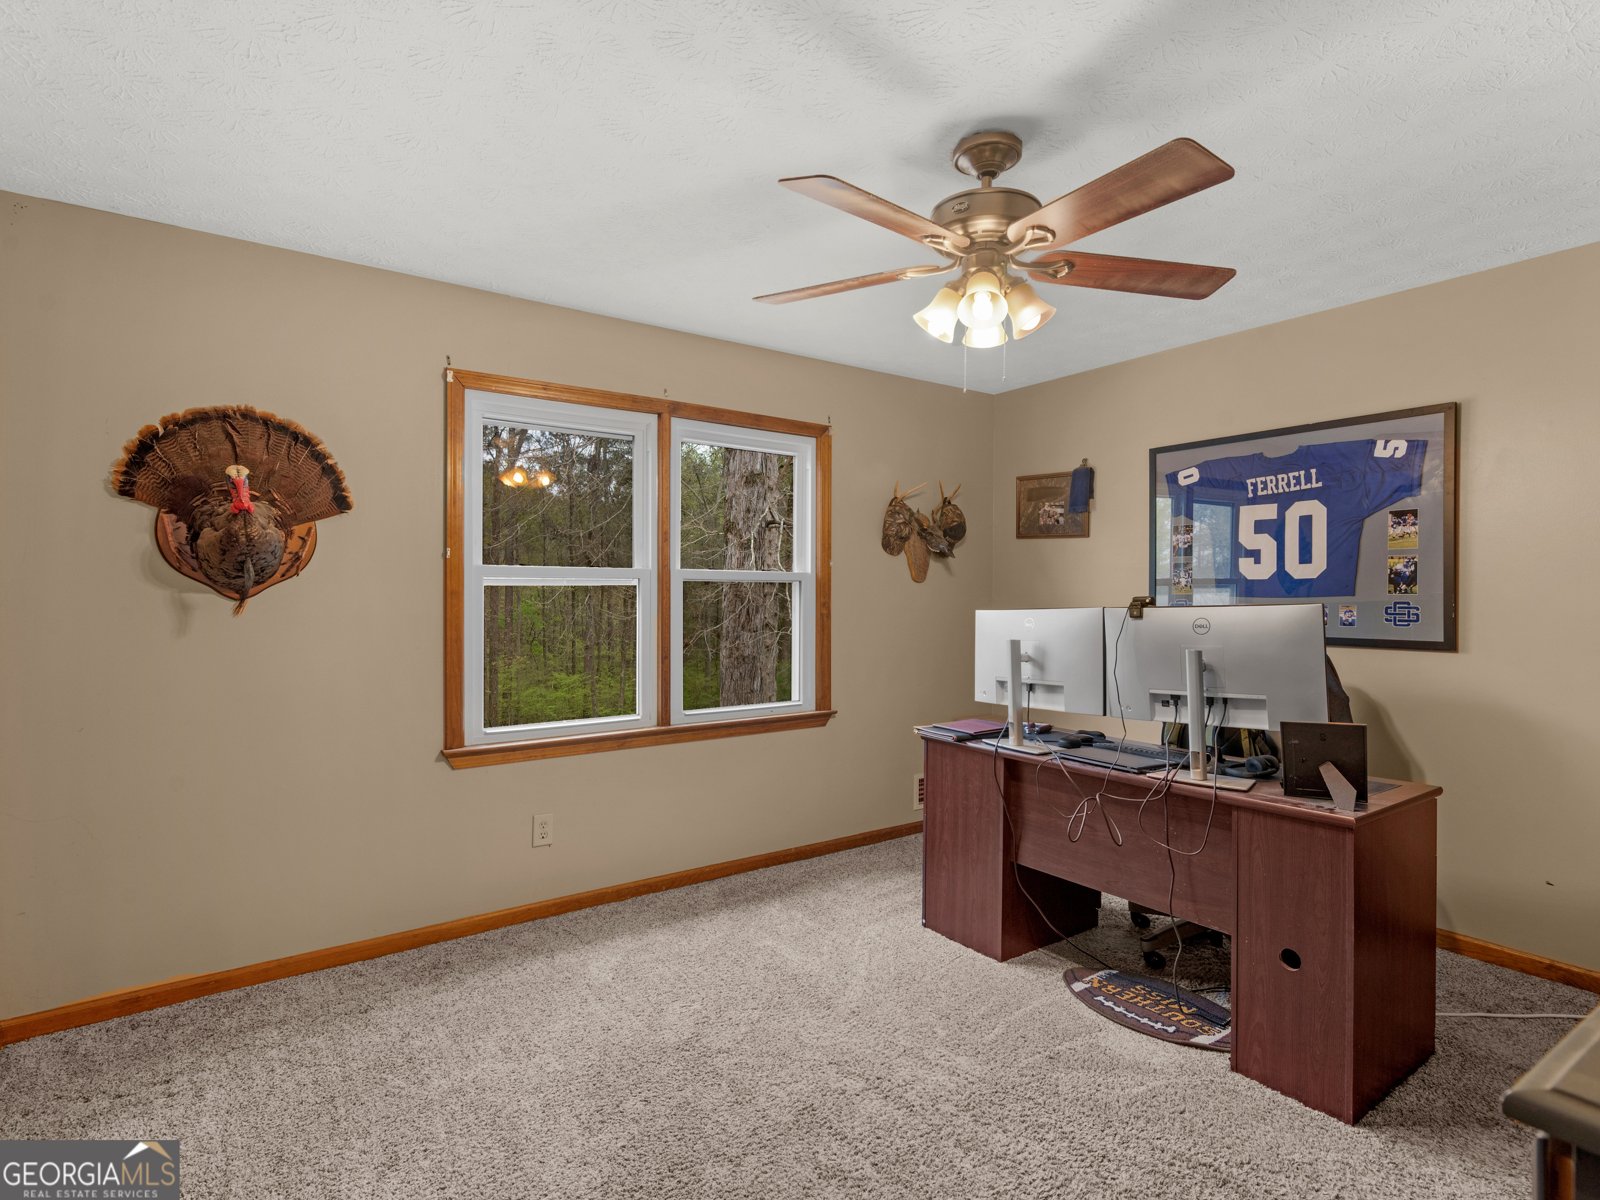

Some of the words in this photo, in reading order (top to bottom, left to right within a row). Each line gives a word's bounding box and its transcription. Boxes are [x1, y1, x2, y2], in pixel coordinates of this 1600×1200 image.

[1246, 468, 1323, 498] FERRELL
[1238, 499, 1328, 581] 50
[1082, 977, 1222, 1036] SOUTHERN
[1131, 984, 1198, 1014] MISS
